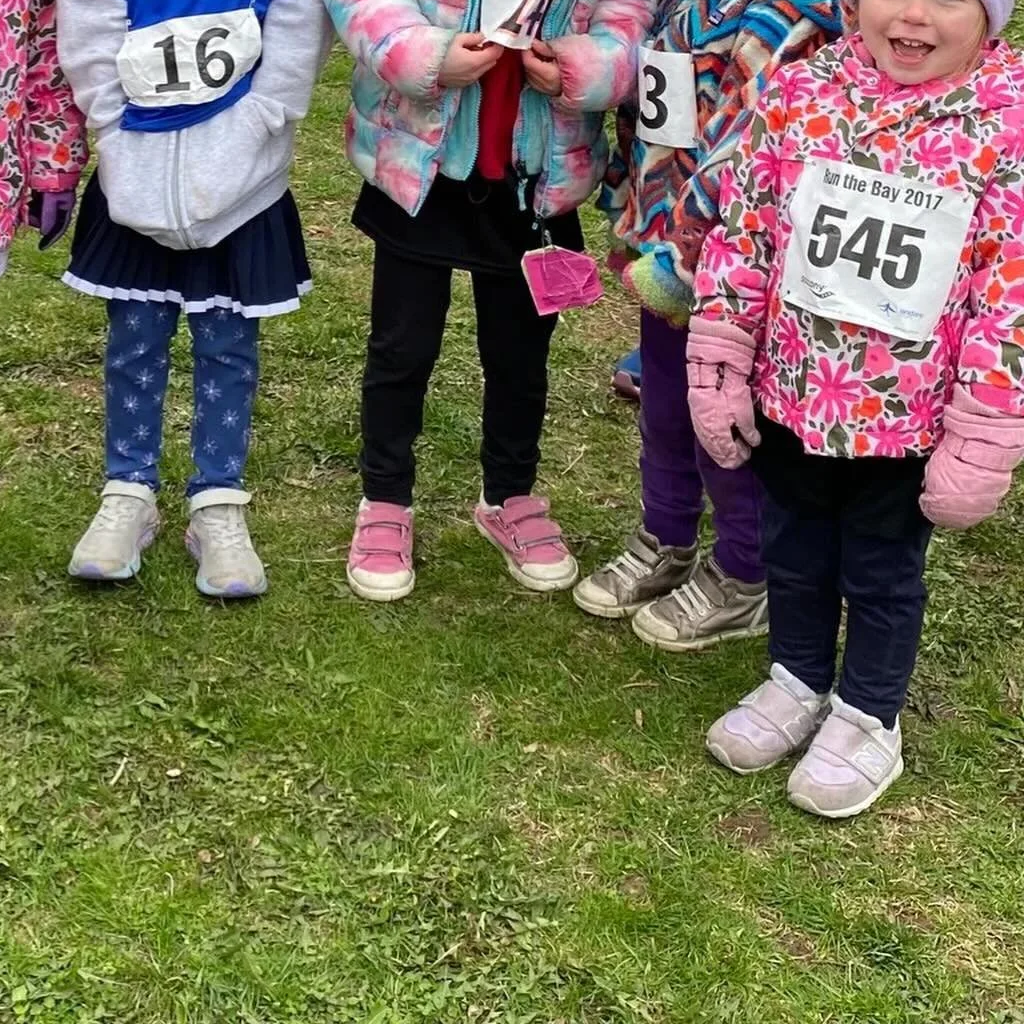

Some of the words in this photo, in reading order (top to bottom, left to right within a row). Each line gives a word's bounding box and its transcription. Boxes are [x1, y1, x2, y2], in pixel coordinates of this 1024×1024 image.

[153, 27, 235, 93] 16
[824, 168, 840, 187] Run
[843, 174, 867, 193] the
[871, 180, 900, 203] Bay
[904, 188, 943, 211] 2017
[807, 204, 926, 289] 545
